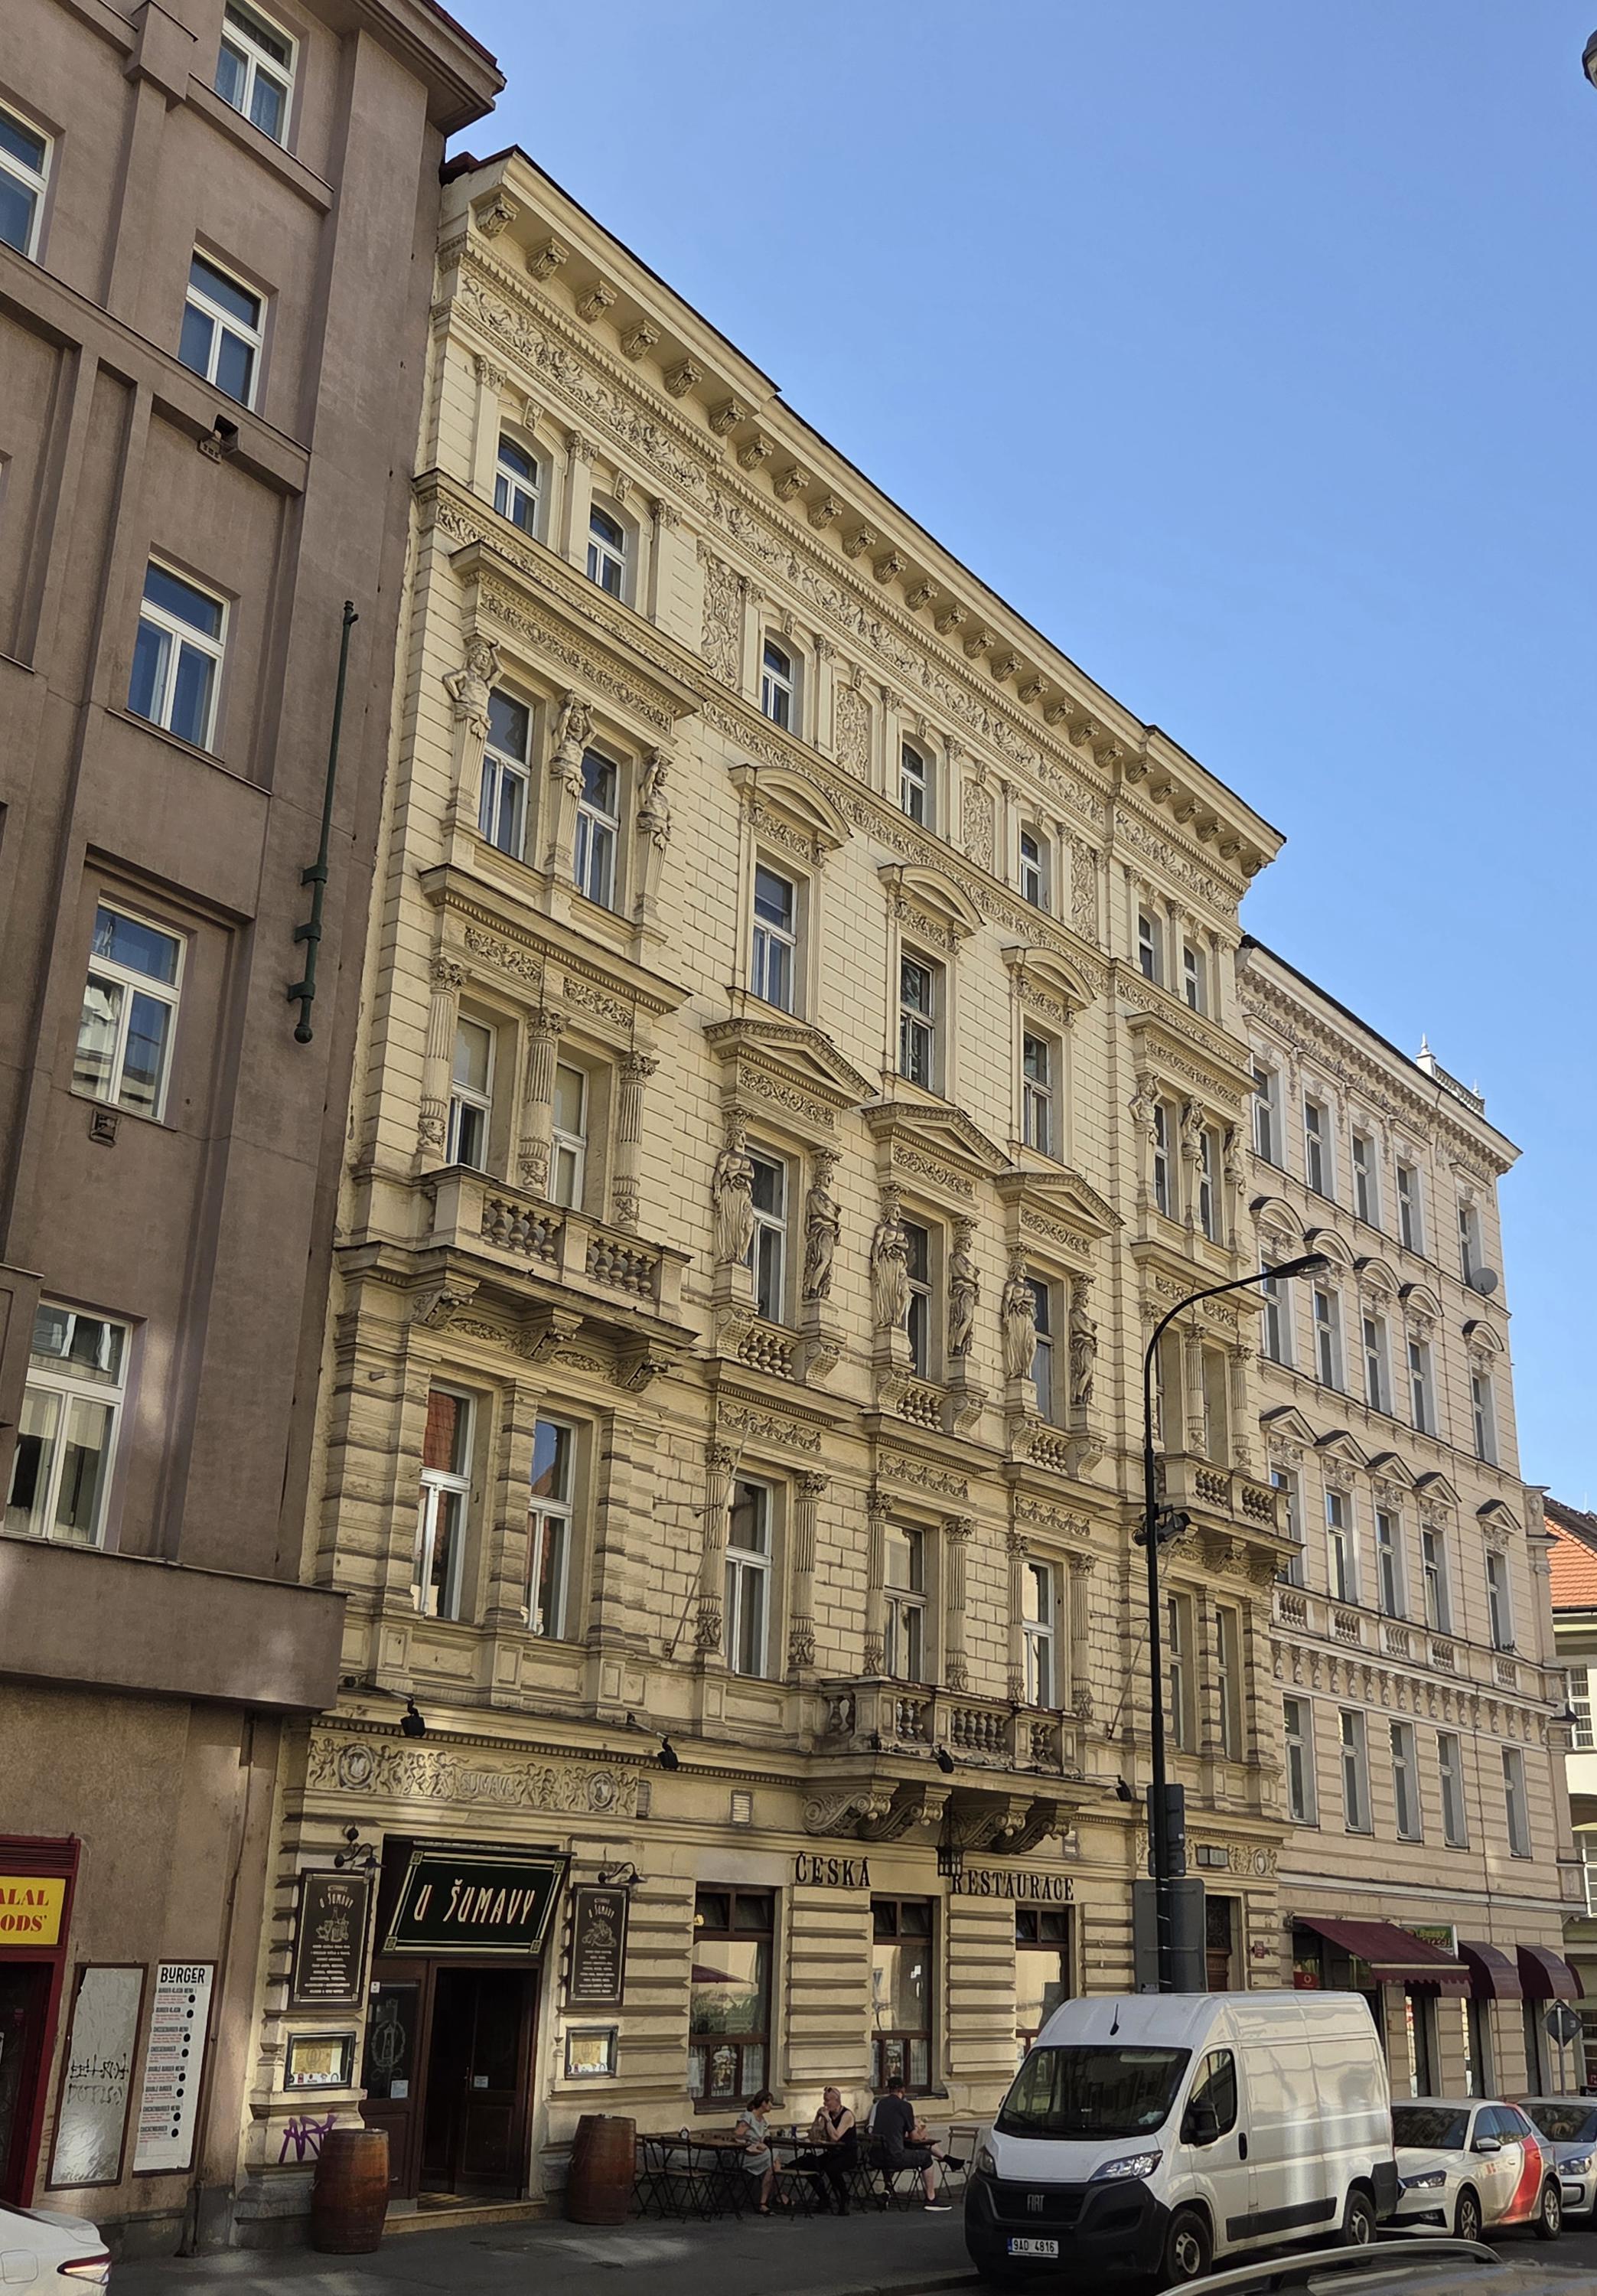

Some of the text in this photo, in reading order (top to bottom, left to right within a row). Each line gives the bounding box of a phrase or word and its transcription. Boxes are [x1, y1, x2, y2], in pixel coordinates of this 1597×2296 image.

[795, 1851, 1074, 1901] ČESKÁ RESTAURACE
[414, 1878, 535, 1924] U ŠUMAVY
[160, 1967, 205, 1984] BURGER
[1027, 2194, 1045, 2212] FIAT
[1035, 2241, 1055, 2252] 4816
